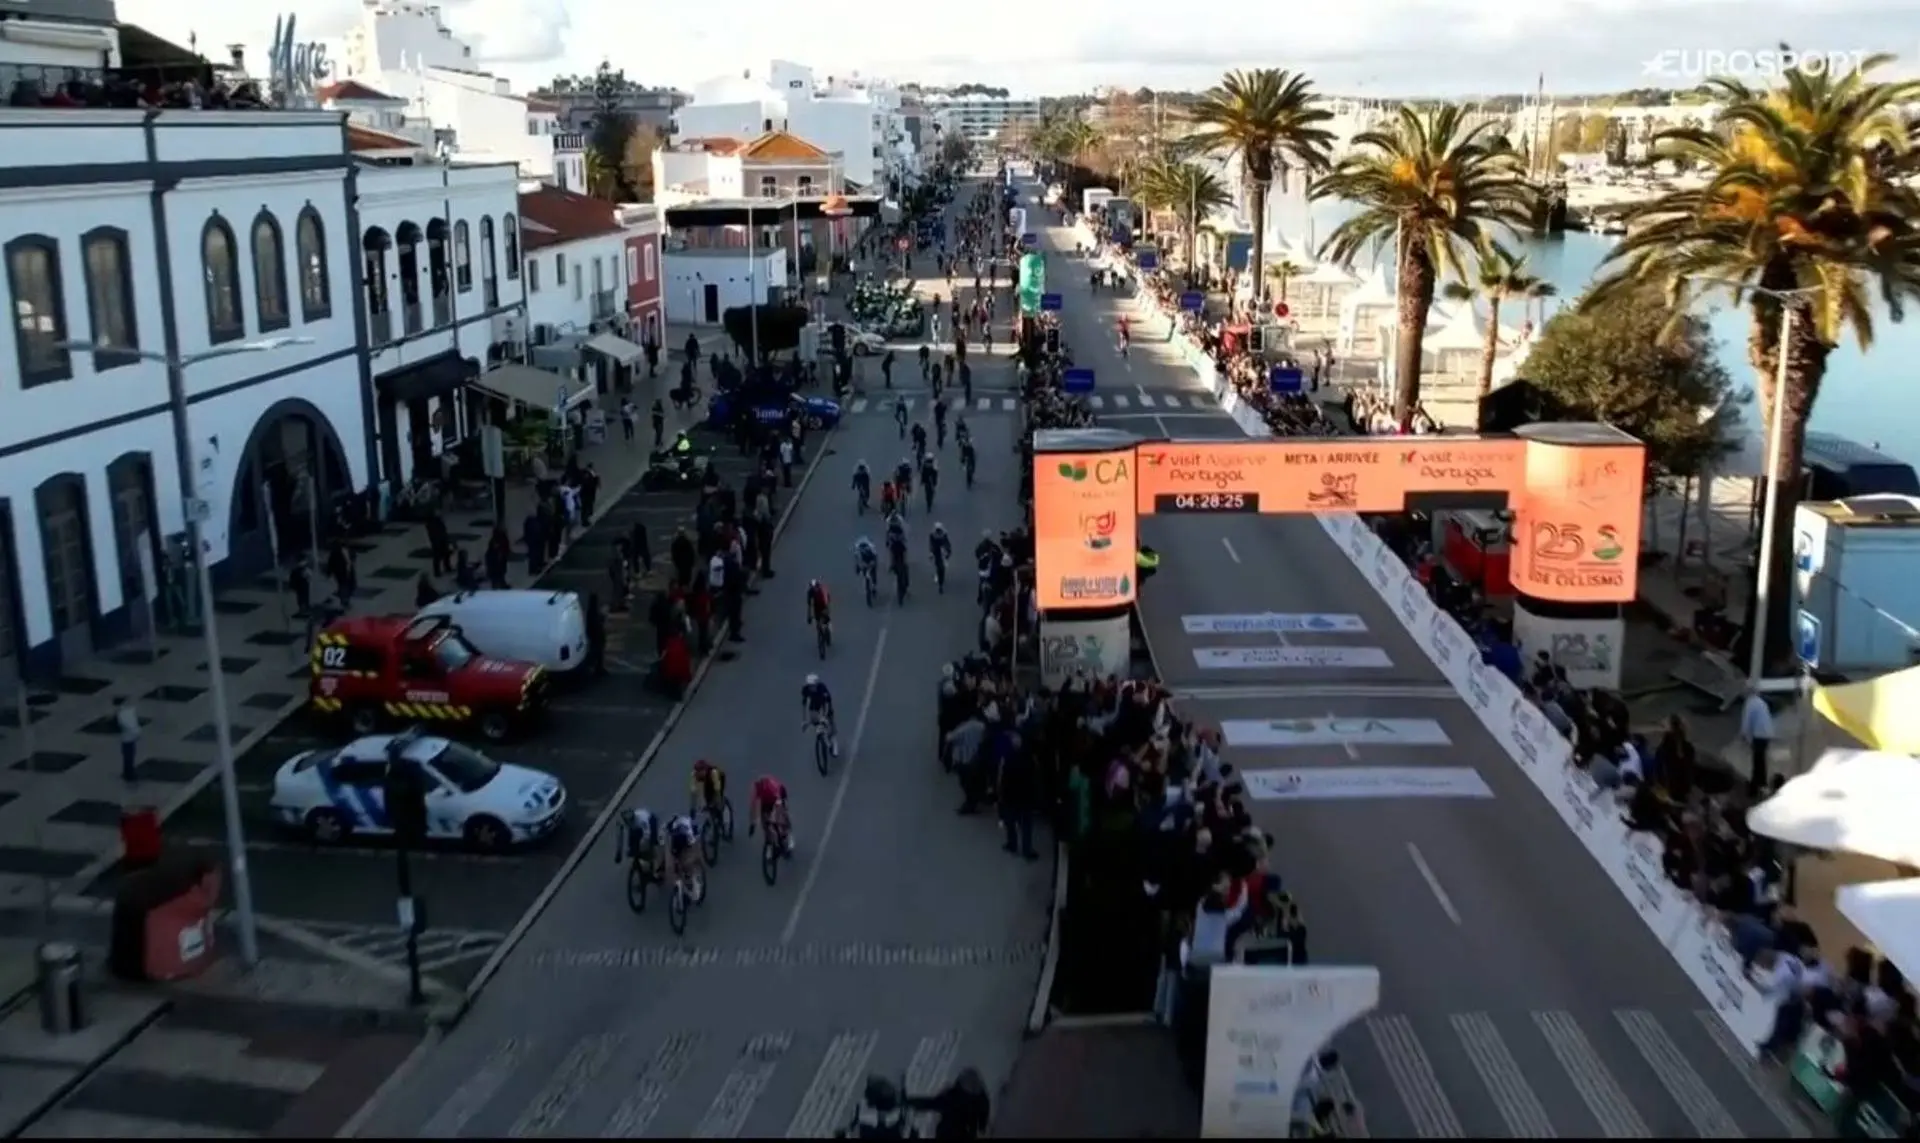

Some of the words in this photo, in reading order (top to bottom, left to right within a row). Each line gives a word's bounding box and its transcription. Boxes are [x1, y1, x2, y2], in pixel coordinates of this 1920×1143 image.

[1170, 453, 1201, 466] visit
[1284, 452, 1318, 464] META
[1095, 459, 1128, 484] CA
[1169, 469, 1245, 489] Portugal
[1175, 494, 1244, 508] 04:28:25
[1556, 574, 1624, 587] CICLISMO
[323, 647, 346, 666] 02
